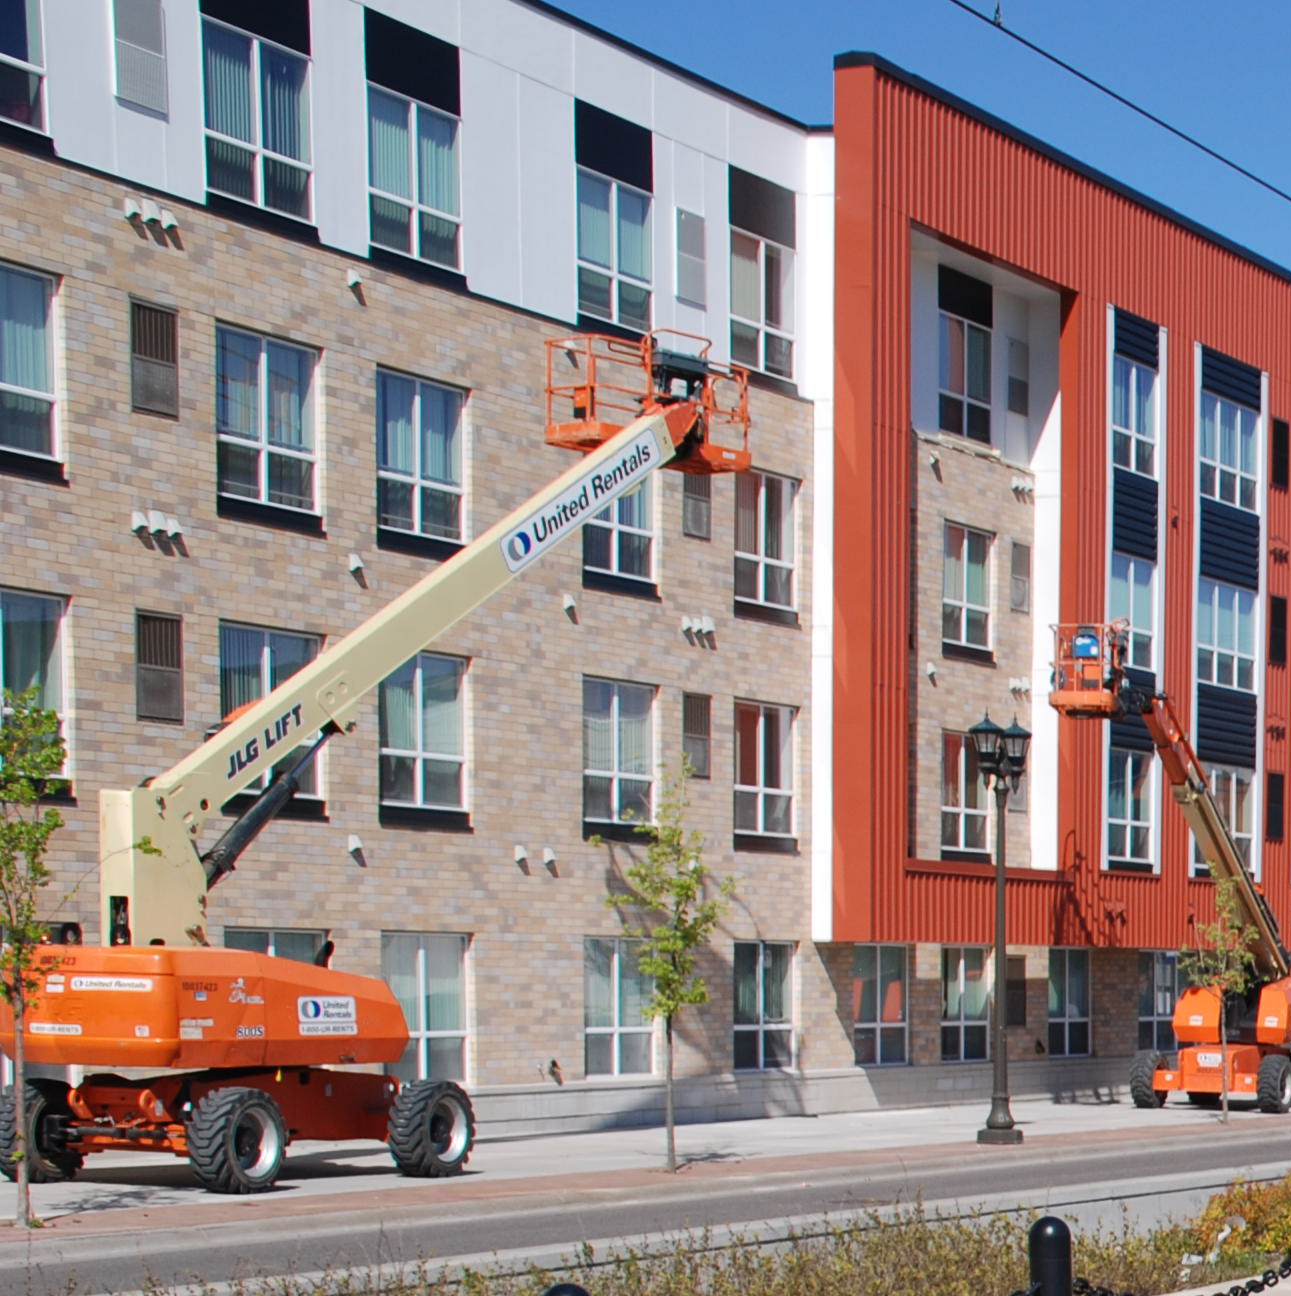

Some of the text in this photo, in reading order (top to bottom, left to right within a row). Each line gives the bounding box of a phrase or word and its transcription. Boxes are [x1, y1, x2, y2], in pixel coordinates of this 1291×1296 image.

[532, 444, 651, 543] United Rentals
[227, 704, 302, 780] JLG LIFT
[85, 979, 113, 988] United
[322, 1000, 349, 1010] United
[322, 1009, 352, 1019] Rentals
